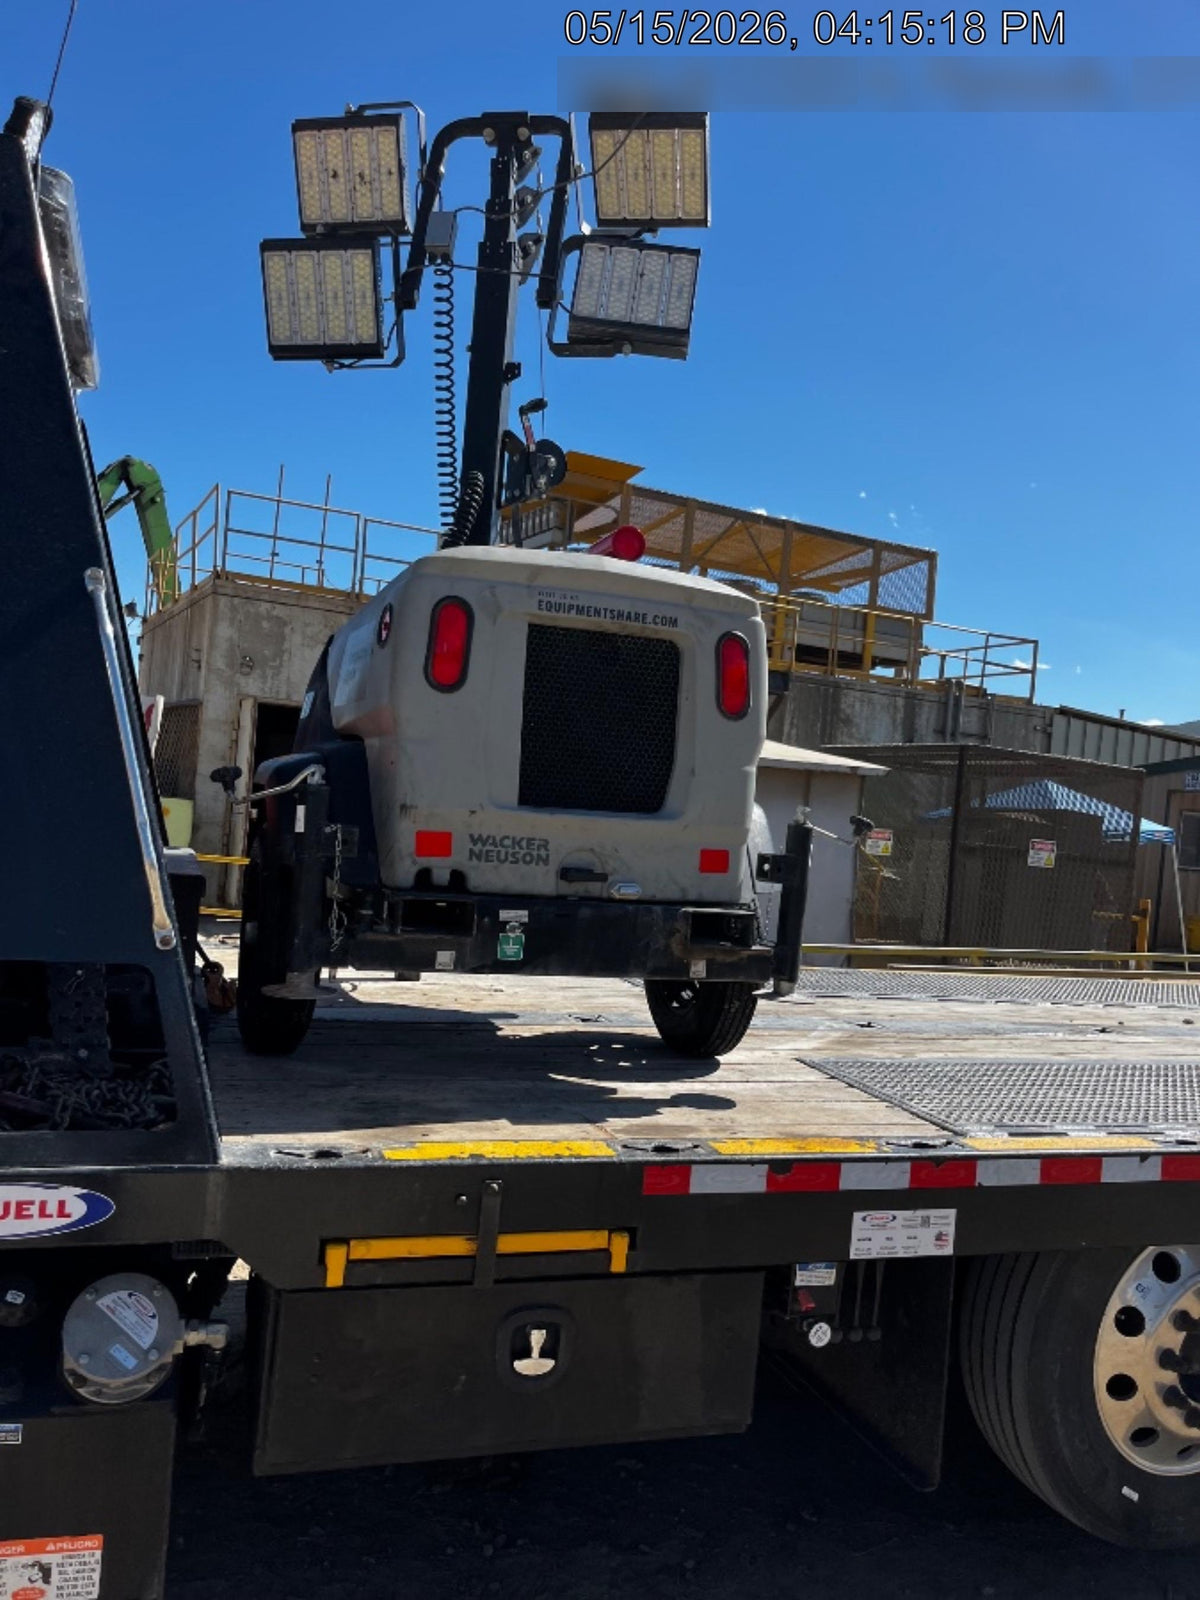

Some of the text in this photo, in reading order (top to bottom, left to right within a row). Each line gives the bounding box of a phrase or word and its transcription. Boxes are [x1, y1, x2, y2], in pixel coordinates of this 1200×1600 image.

[538, 600, 679, 628] EQUIPMENTSHARE.COM
[469, 833, 550, 852] WACKER
[468, 848, 550, 866] NEUSON
